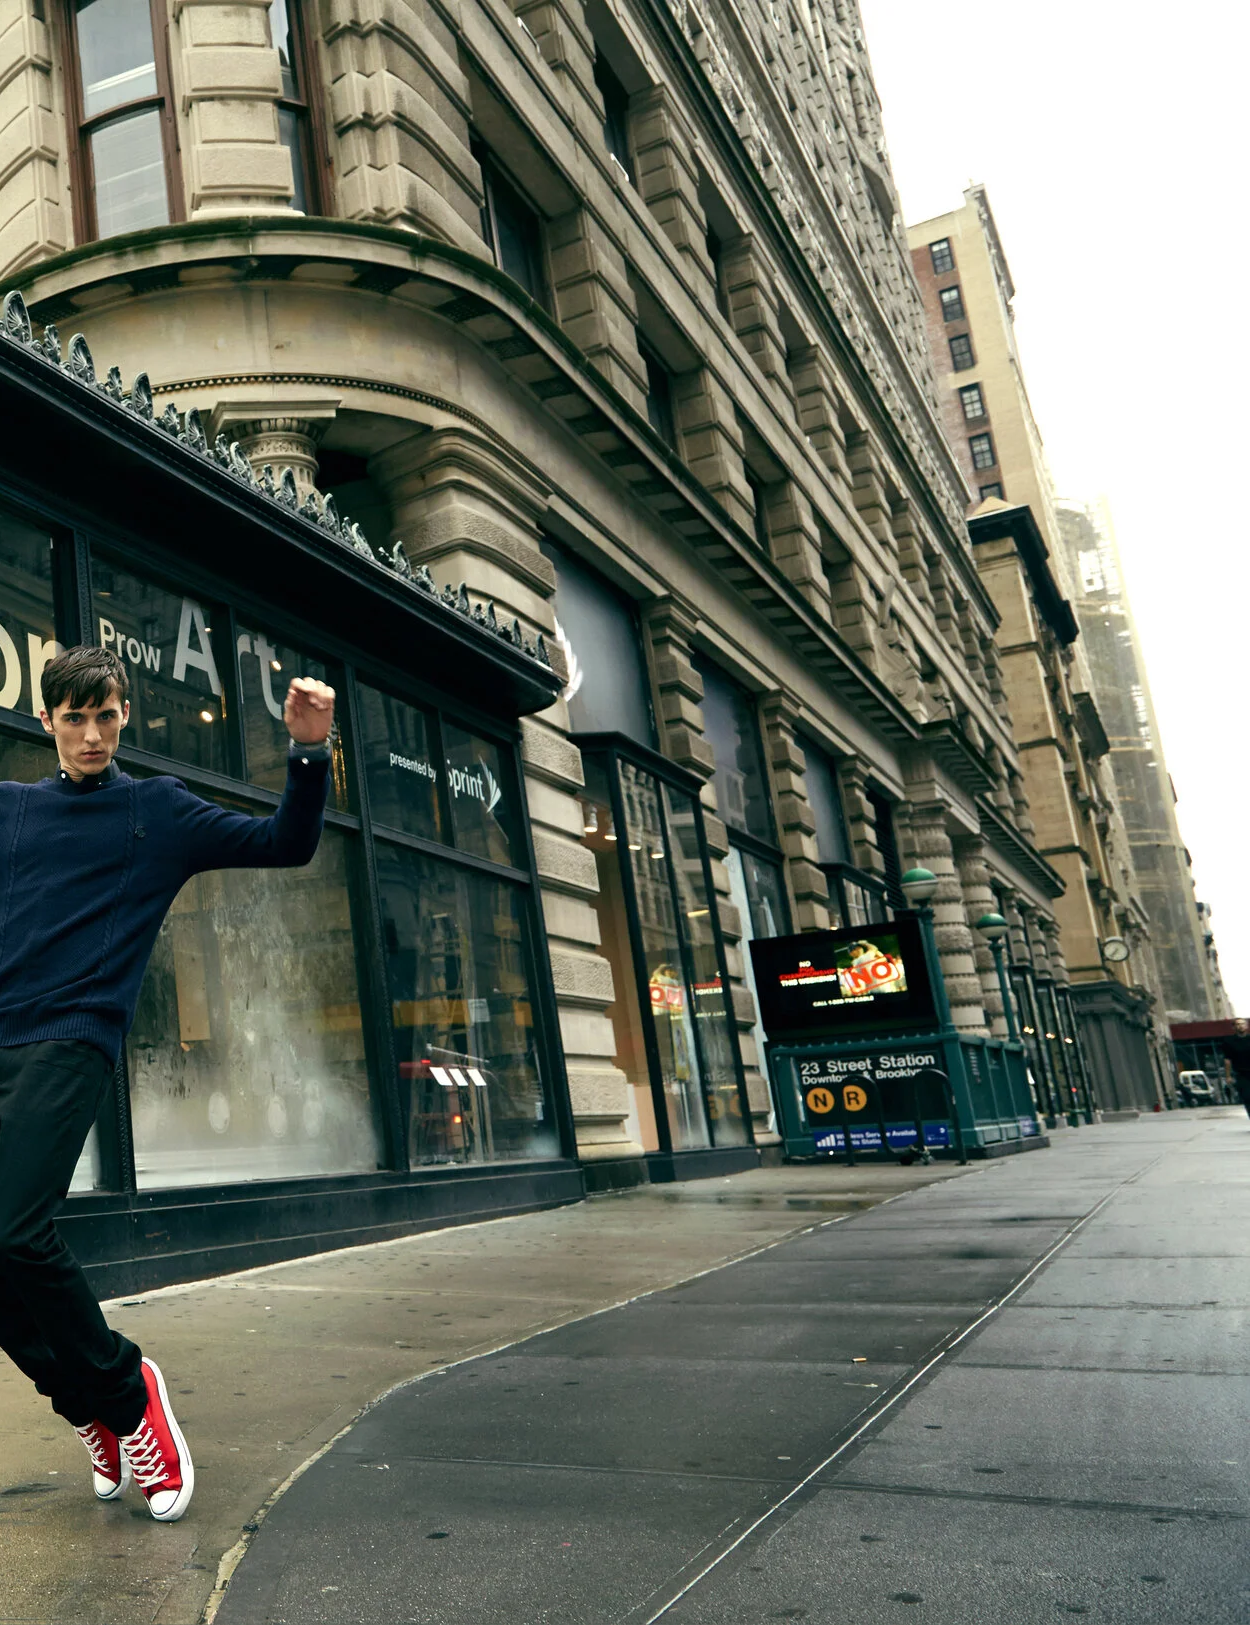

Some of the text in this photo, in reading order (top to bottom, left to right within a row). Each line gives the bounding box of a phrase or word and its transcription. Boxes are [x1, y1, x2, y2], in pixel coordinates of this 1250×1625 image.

[100, 617, 161, 673] Prow
[390, 752, 437, 783] presented by
[799, 960, 812, 968] NO
[851, 961, 892, 989] NO
[800, 1054, 935, 1076] 23 Street Station
[802, 1074, 848, 1085] Downto
[875, 1068, 922, 1080] Brookly
[813, 1091, 860, 1108] N R
